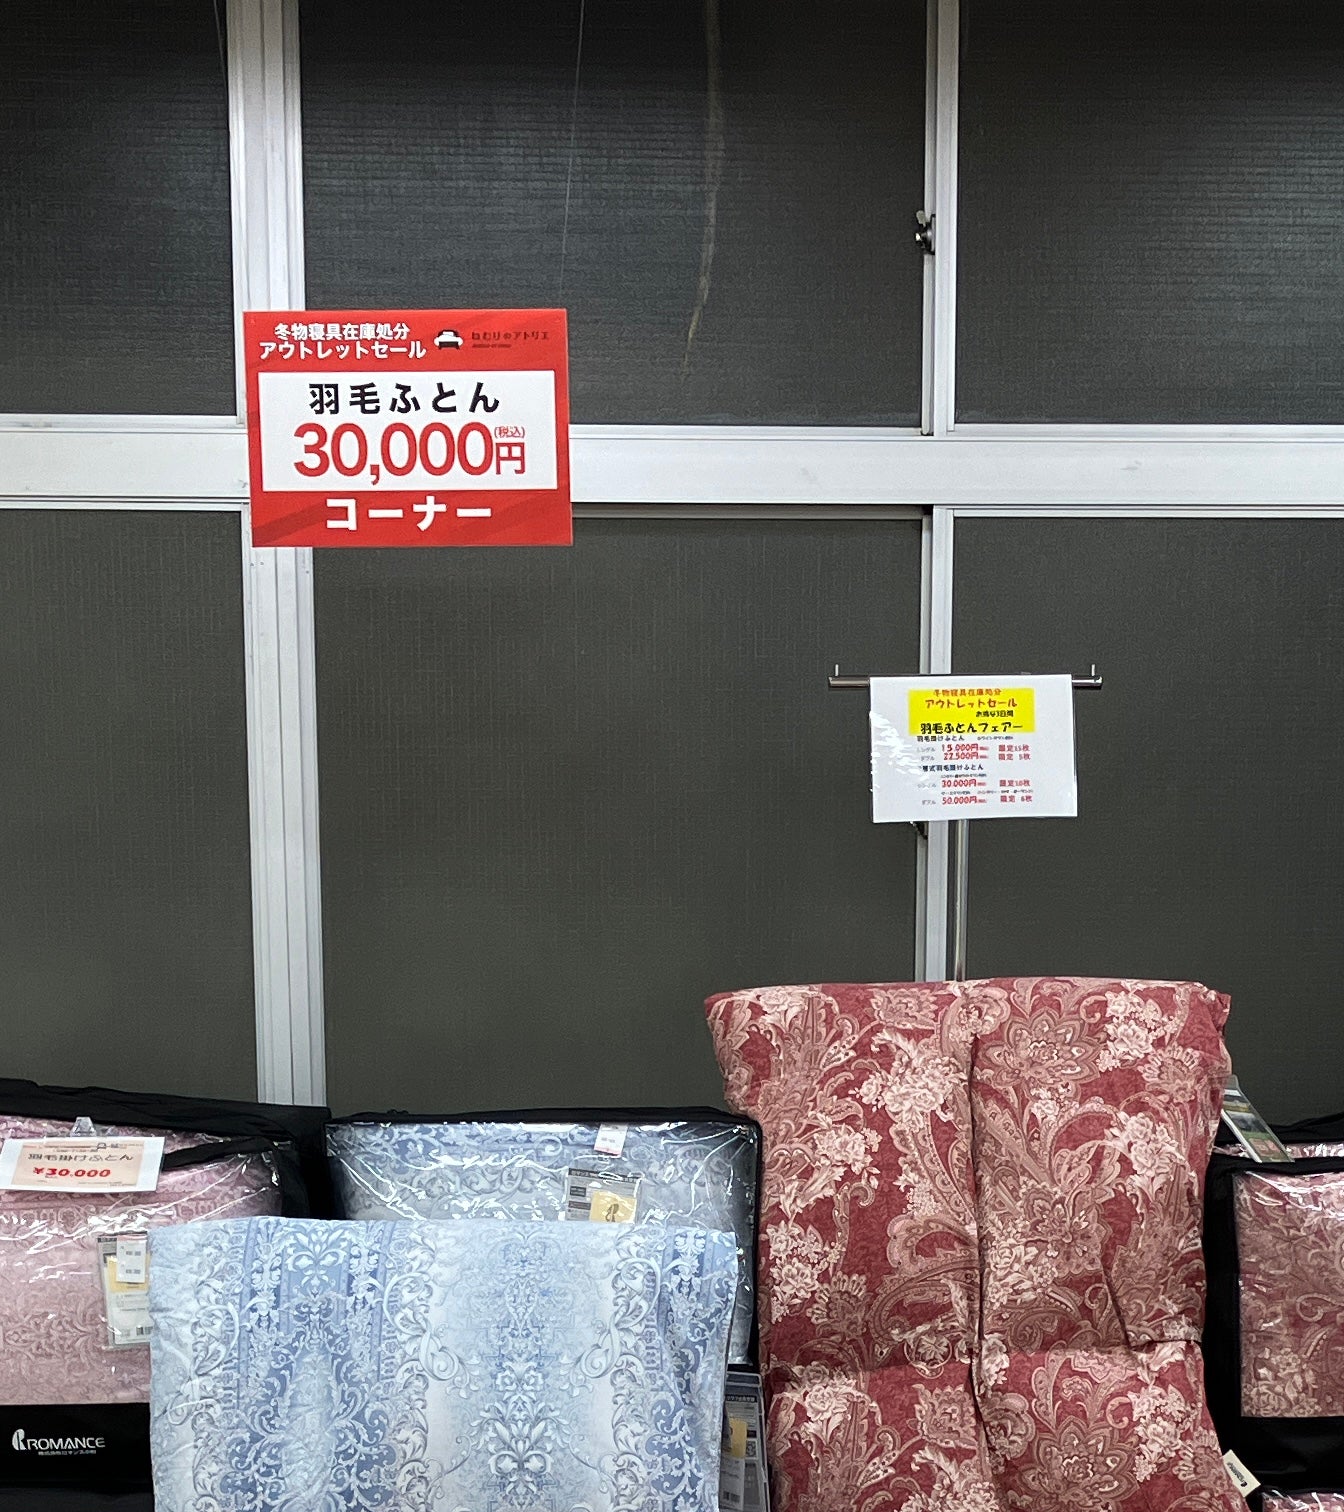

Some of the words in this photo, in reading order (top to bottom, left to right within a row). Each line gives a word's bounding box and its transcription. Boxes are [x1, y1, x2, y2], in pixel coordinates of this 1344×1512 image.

[274, 323, 410, 340] 冬物寝具在庫処分
[258, 341, 427, 360] アウトレットセール
[309, 382, 499, 415] 羽毛ふとん
[326, 496, 492, 531] コーナー
[925, 698, 1018, 709] アウトレットセール
[920, 722, 1023, 734] 羽毛ふとんフェアー
[26, 1437, 106, 1450] ROMANCE
